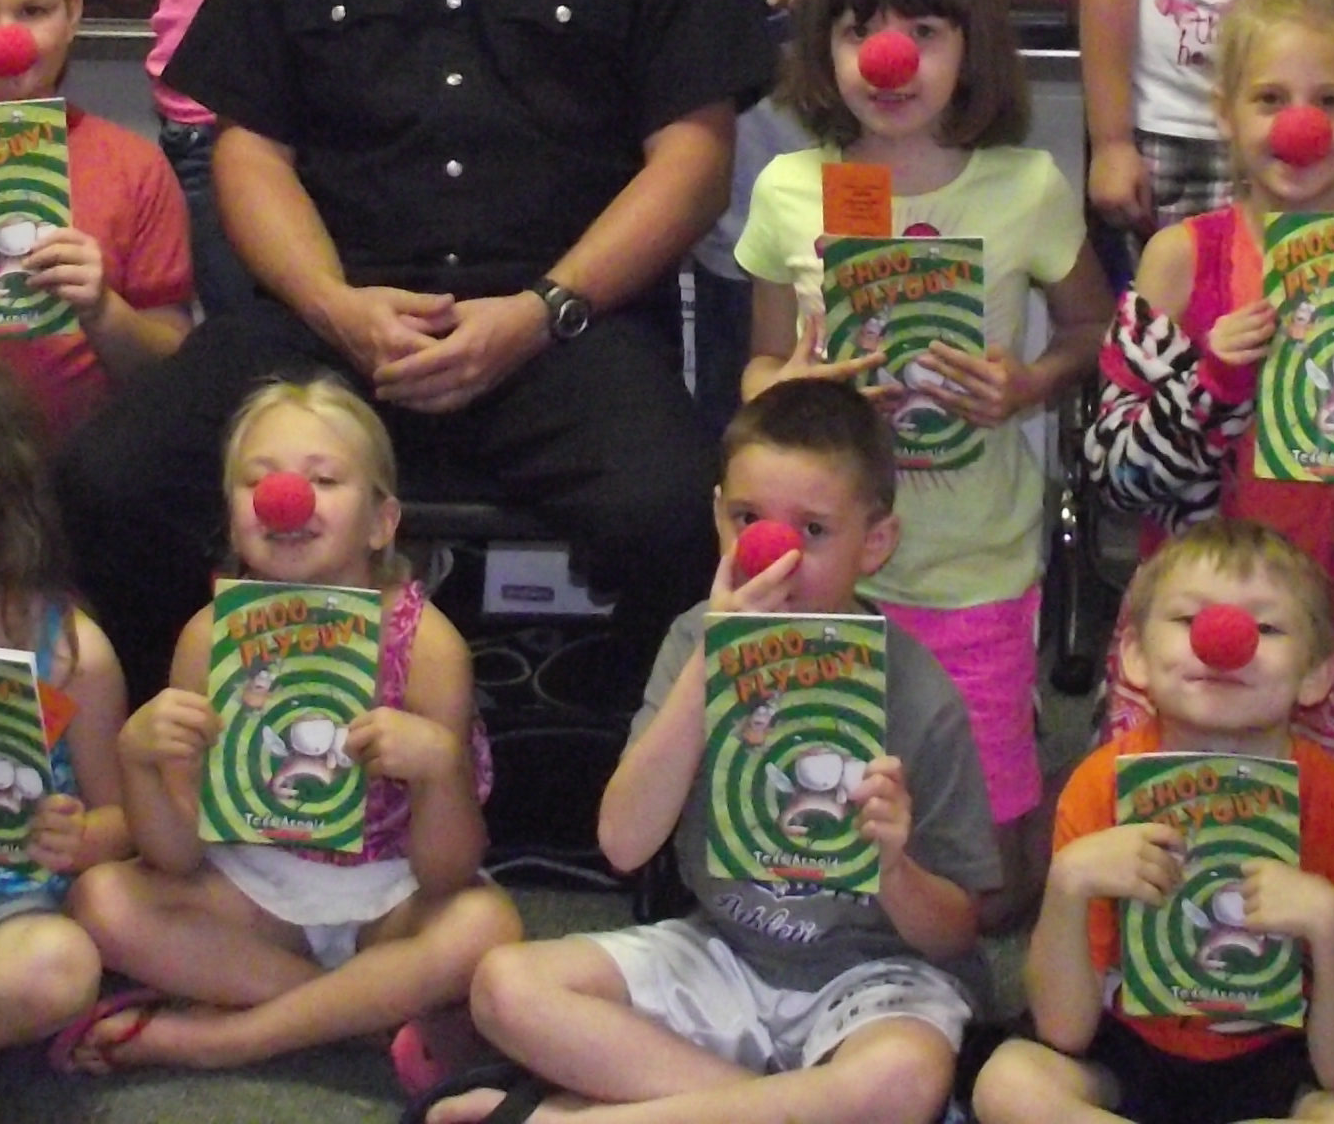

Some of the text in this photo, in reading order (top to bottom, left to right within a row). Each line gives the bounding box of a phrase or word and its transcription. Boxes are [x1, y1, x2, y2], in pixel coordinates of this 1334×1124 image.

[299, 614, 366, 653] GUY!
[794, 643, 872, 687] GUY!
[1210, 783, 1285, 825] GUY!
